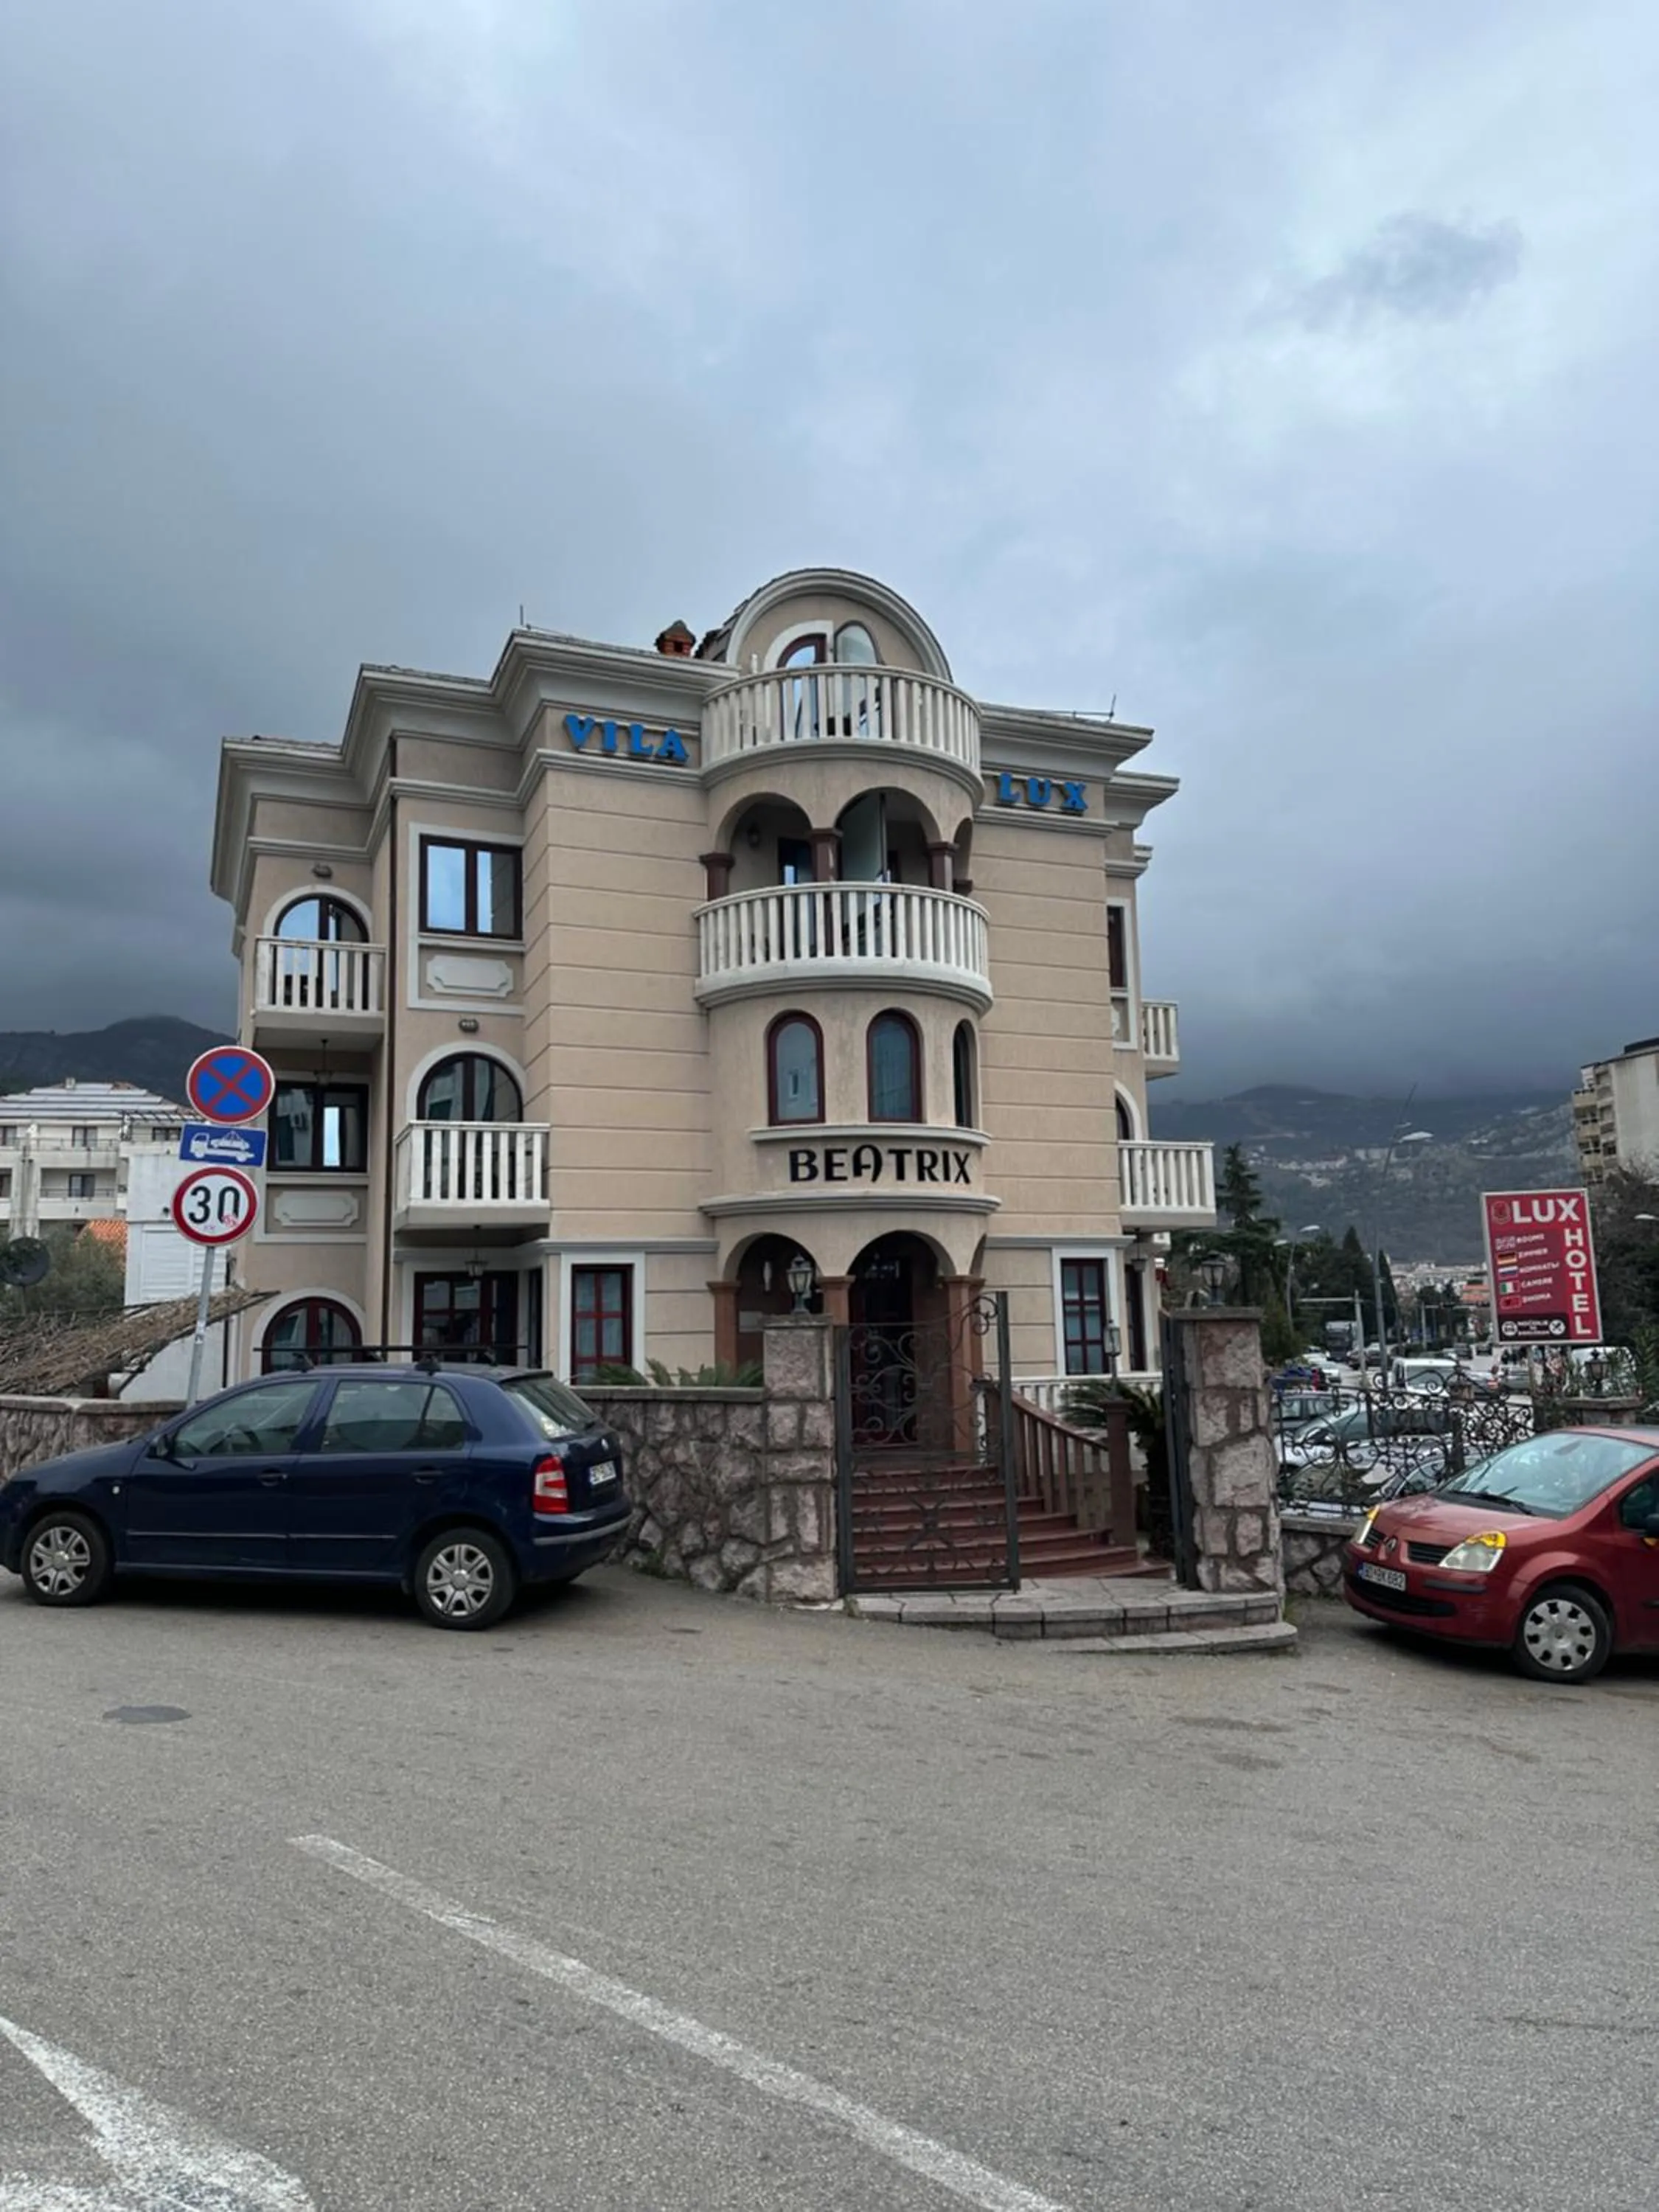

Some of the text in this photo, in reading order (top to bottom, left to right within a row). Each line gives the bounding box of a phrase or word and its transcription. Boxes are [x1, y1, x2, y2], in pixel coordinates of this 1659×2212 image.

[564, 714, 690, 762] VILA
[999, 772, 1088, 810] LUX
[789, 1144, 971, 1184] BEATRIX
[189, 1185, 240, 1224] 30
[1512, 1198, 1581, 1224] LUX
[1564, 1228, 1592, 1335] HOTEL
